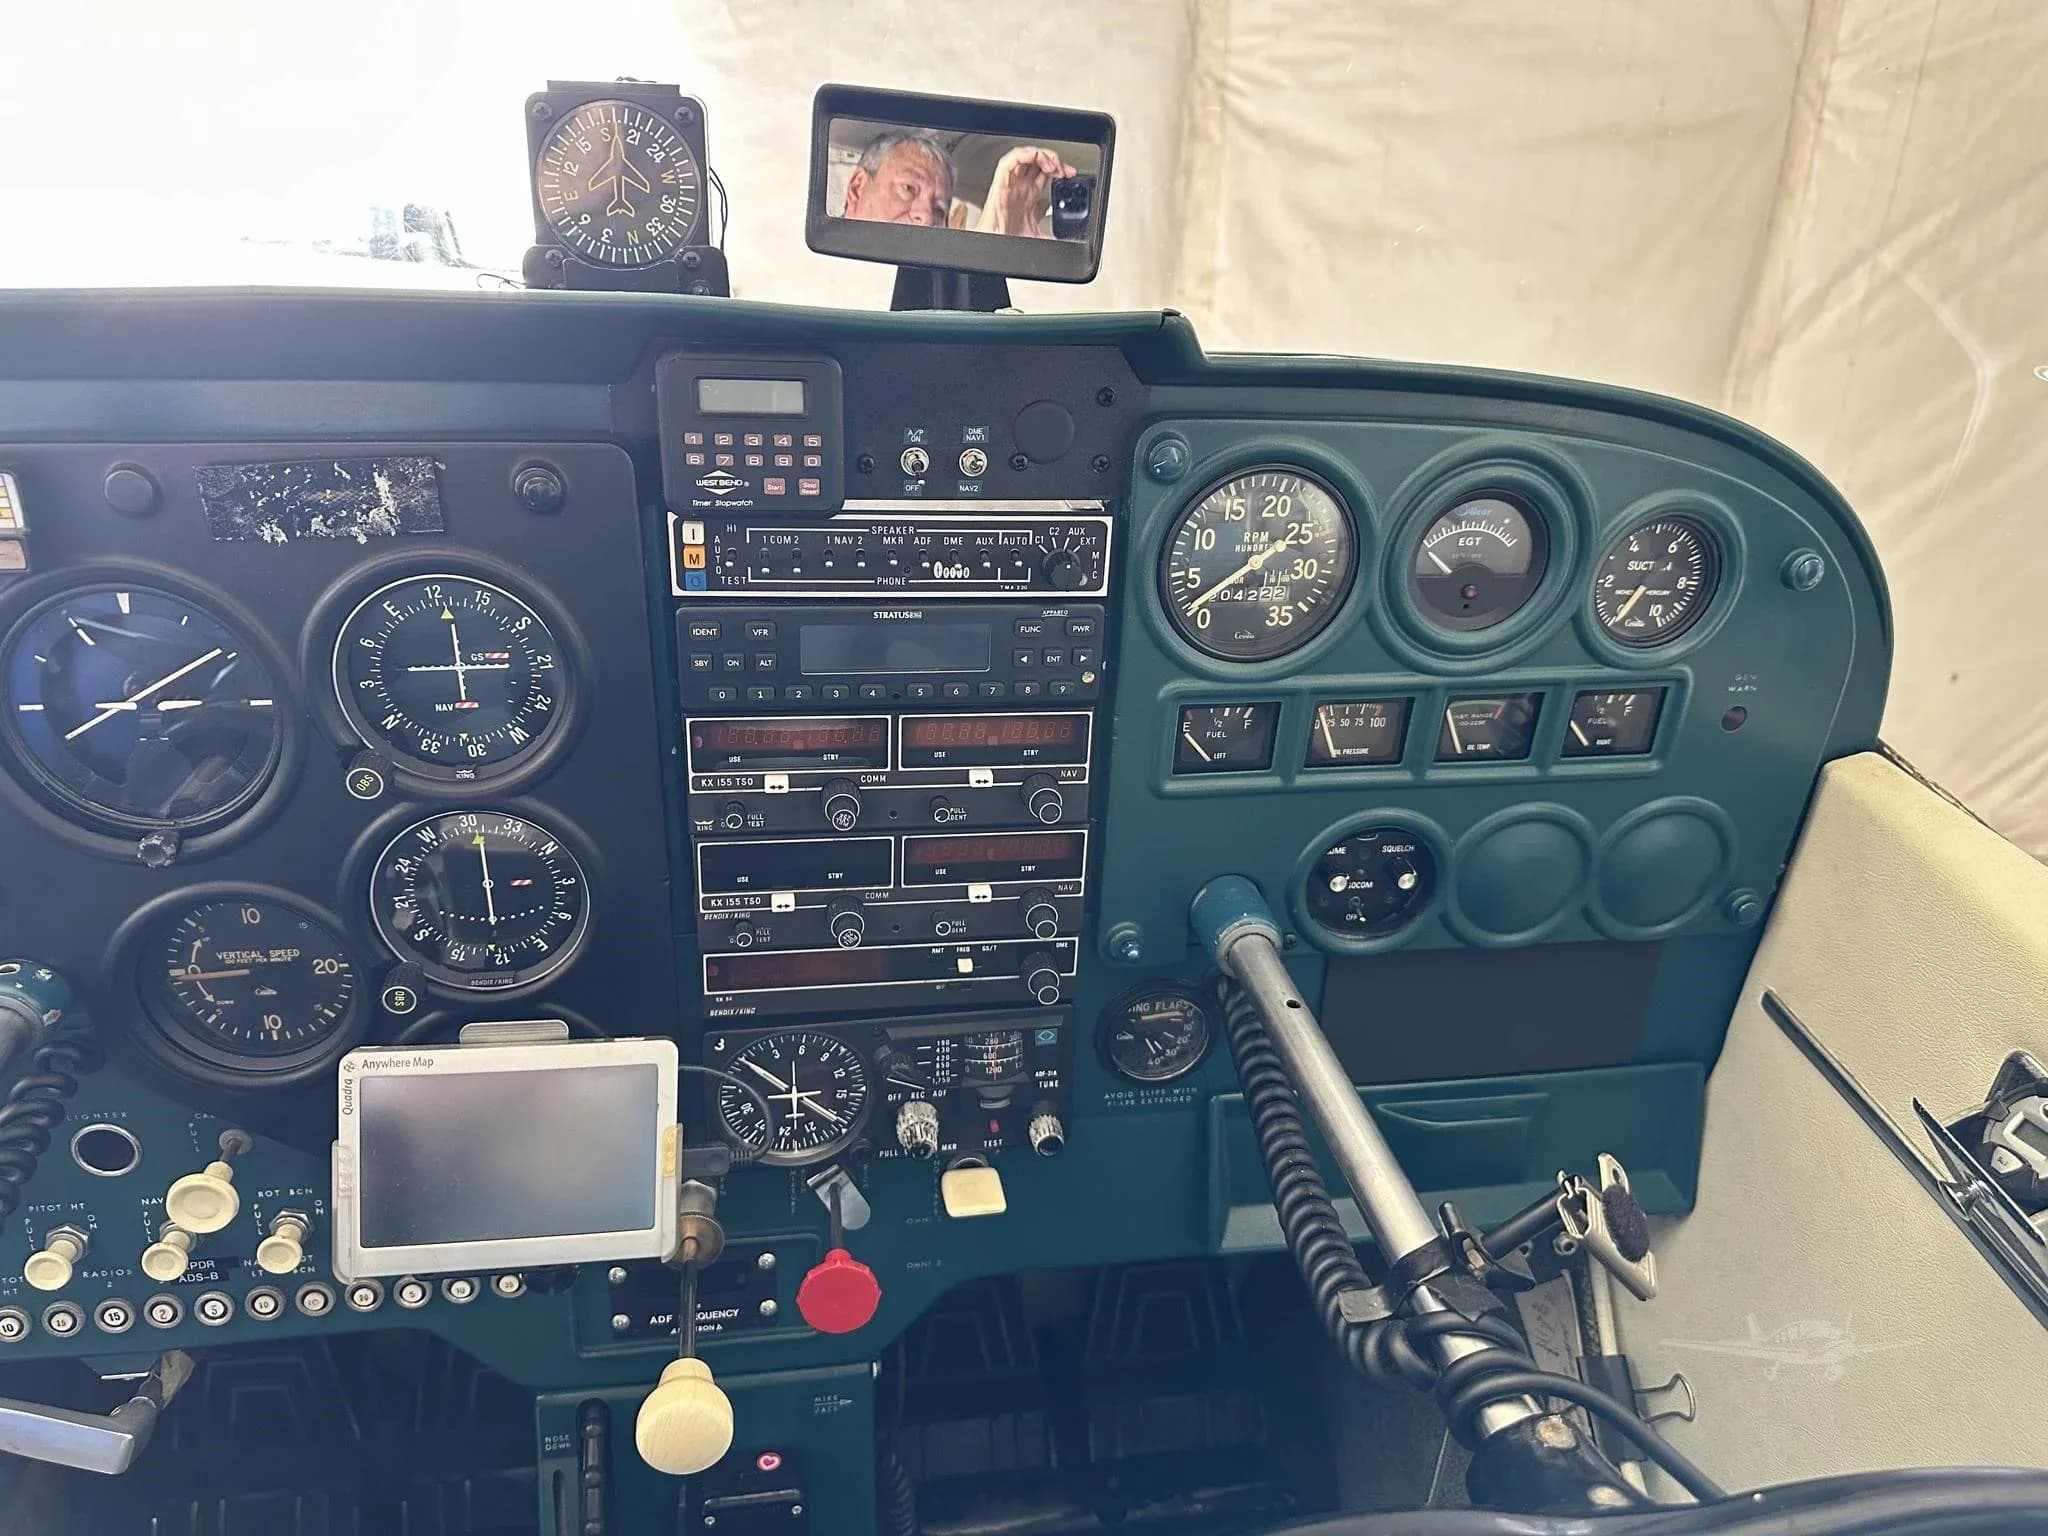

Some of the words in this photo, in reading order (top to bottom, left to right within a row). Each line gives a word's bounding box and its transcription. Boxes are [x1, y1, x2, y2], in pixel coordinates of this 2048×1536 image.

[627, 129, 640, 145] 21
[576, 137, 592, 155] 15
[646, 144, 666, 163] 24
[660, 195, 677, 213] 30
[646, 217, 665, 236] 33
[1224, 498, 1246, 520] 15
[1261, 495, 1291, 517] 20
[770, 536, 791, 544] COM
[1194, 528, 1216, 550] 10
[1244, 532, 1269, 542] RPM
[1285, 523, 1313, 545] 25
[914, 537, 931, 545] ADF
[1458, 537, 1482, 546] EGT
[1630, 540, 1639, 552] 4
[1290, 559, 1317, 580] 30
[1627, 561, 1654, 571] SUCT
[1186, 568, 1201, 588] 5
[424, 585, 442, 599] 12
[475, 590, 492, 605] 15
[1266, 606, 1293, 627] 35
[1649, 604, 1662, 617] 10
[1196, 608, 1211, 629] 0
[537, 655, 554, 669] 21
[534, 694, 551, 711] 24
[1340, 718, 1349, 727] 50
[1354, 718, 1363, 726] 75
[1370, 718, 1385, 728] 100
[421, 739, 441, 753] 33
[468, 744, 486, 757] 30
[860, 775, 886, 783] COMM
[1061, 770, 1077, 778] NAV
[356, 775, 373, 791] OBS
[459, 815, 478, 827] 30
[504, 819, 522, 832] 33
[1382, 845, 1414, 853] SQUELCH
[395, 858, 411, 873] 24
[393, 896, 409, 908] 21
[711, 899, 722, 907] KX
[241, 908, 261, 924] 10
[216, 951, 263, 960] VERTICAL
[269, 949, 300, 958] SPEED
[451, 949, 465, 961] 15
[495, 953, 510, 965] 12
[313, 959, 338, 974] 20
[395, 991, 404, 1006] OBS
[1155, 1001, 1188, 1010] FLAPS
[264, 1015, 281, 1029] 10
[362, 1058, 411, 1069] Anywhere
[413, 1057, 434, 1068] Map
[833, 1068, 845, 1079] 12
[341, 1079, 353, 1115] Quadra
[836, 1089, 847, 1099] 15
[1141, 1095, 1192, 1104] EXTENDED
[67, 1112, 127, 1120] LIGHTER
[779, 1126, 791, 1136] 24
[804, 1121, 816, 1133] 21
[28, 1204, 61, 1212] PITOT
[83, 1269, 132, 1277] RADIOS
[179, 1272, 218, 1283] ADS-B
[109, 1312, 120, 1321] 15
[650, 1315, 672, 1324] ADF
[2, 1324, 14, 1332] 10
